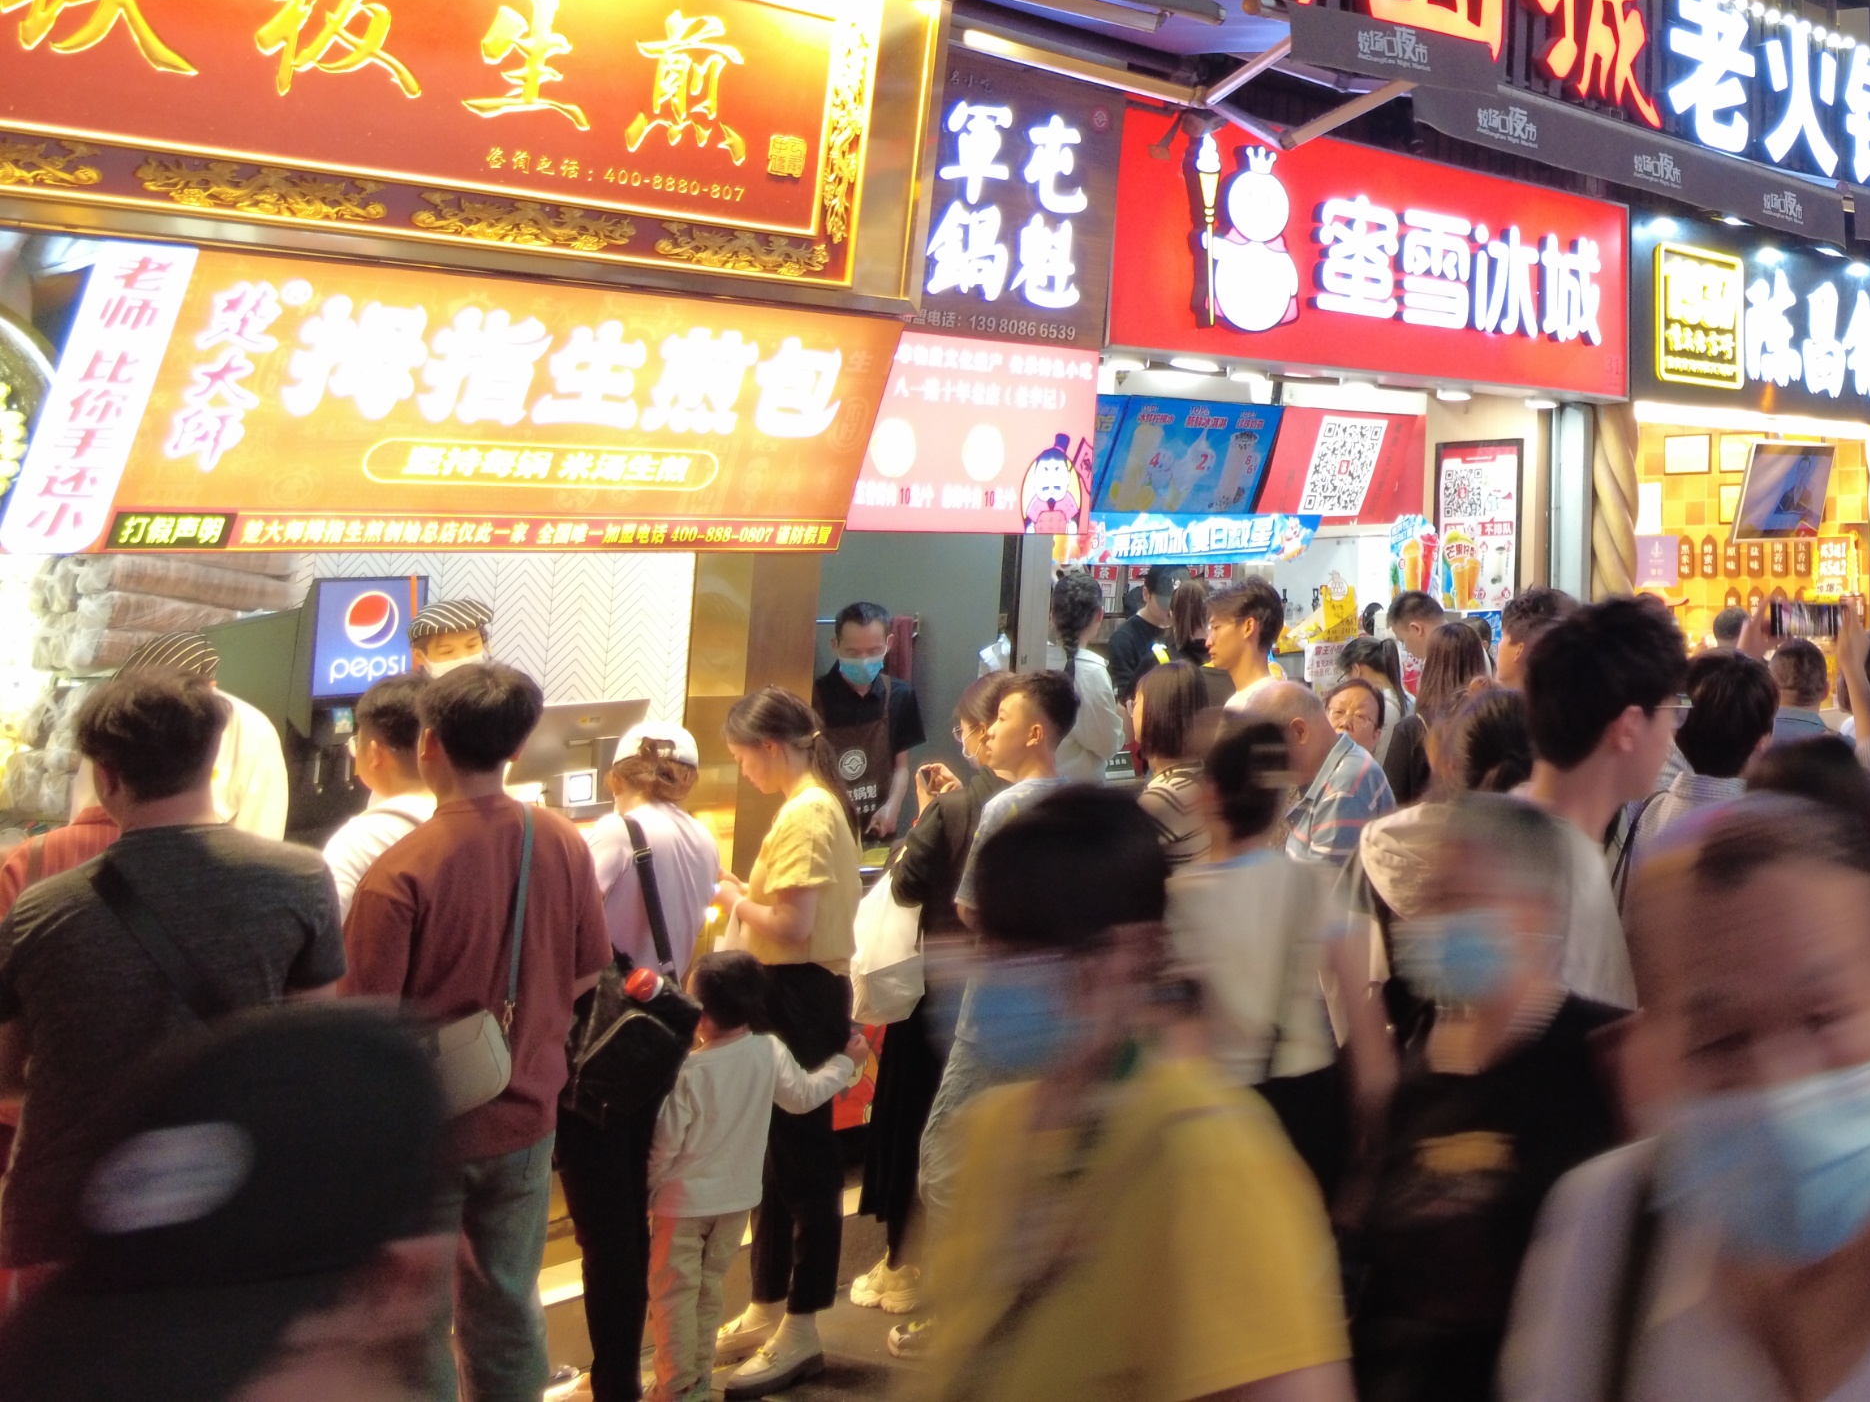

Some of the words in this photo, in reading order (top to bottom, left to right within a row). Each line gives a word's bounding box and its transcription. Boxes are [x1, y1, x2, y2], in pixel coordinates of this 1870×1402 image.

[1317, 195, 1602, 347] 蜜雪冰城
[99, 255, 174, 331] 老师
[970, 314, 996, 332] 139
[999, 318, 1037, 337] 8086
[1040, 323, 1077, 341] 6539
[27, 349, 140, 538] 比你手还小
[118, 514, 226, 544] 打假声明
[535, 522, 669, 545] 全国唯一加盟电话
[670, 526, 774, 543] 400-888-0807
[775, 525, 833, 546] 谨防假冒
[1703, 544, 1714, 576] 蜂蜜味
[1726, 545, 1737, 571] 原味
[329, 654, 406, 684] pepsi
